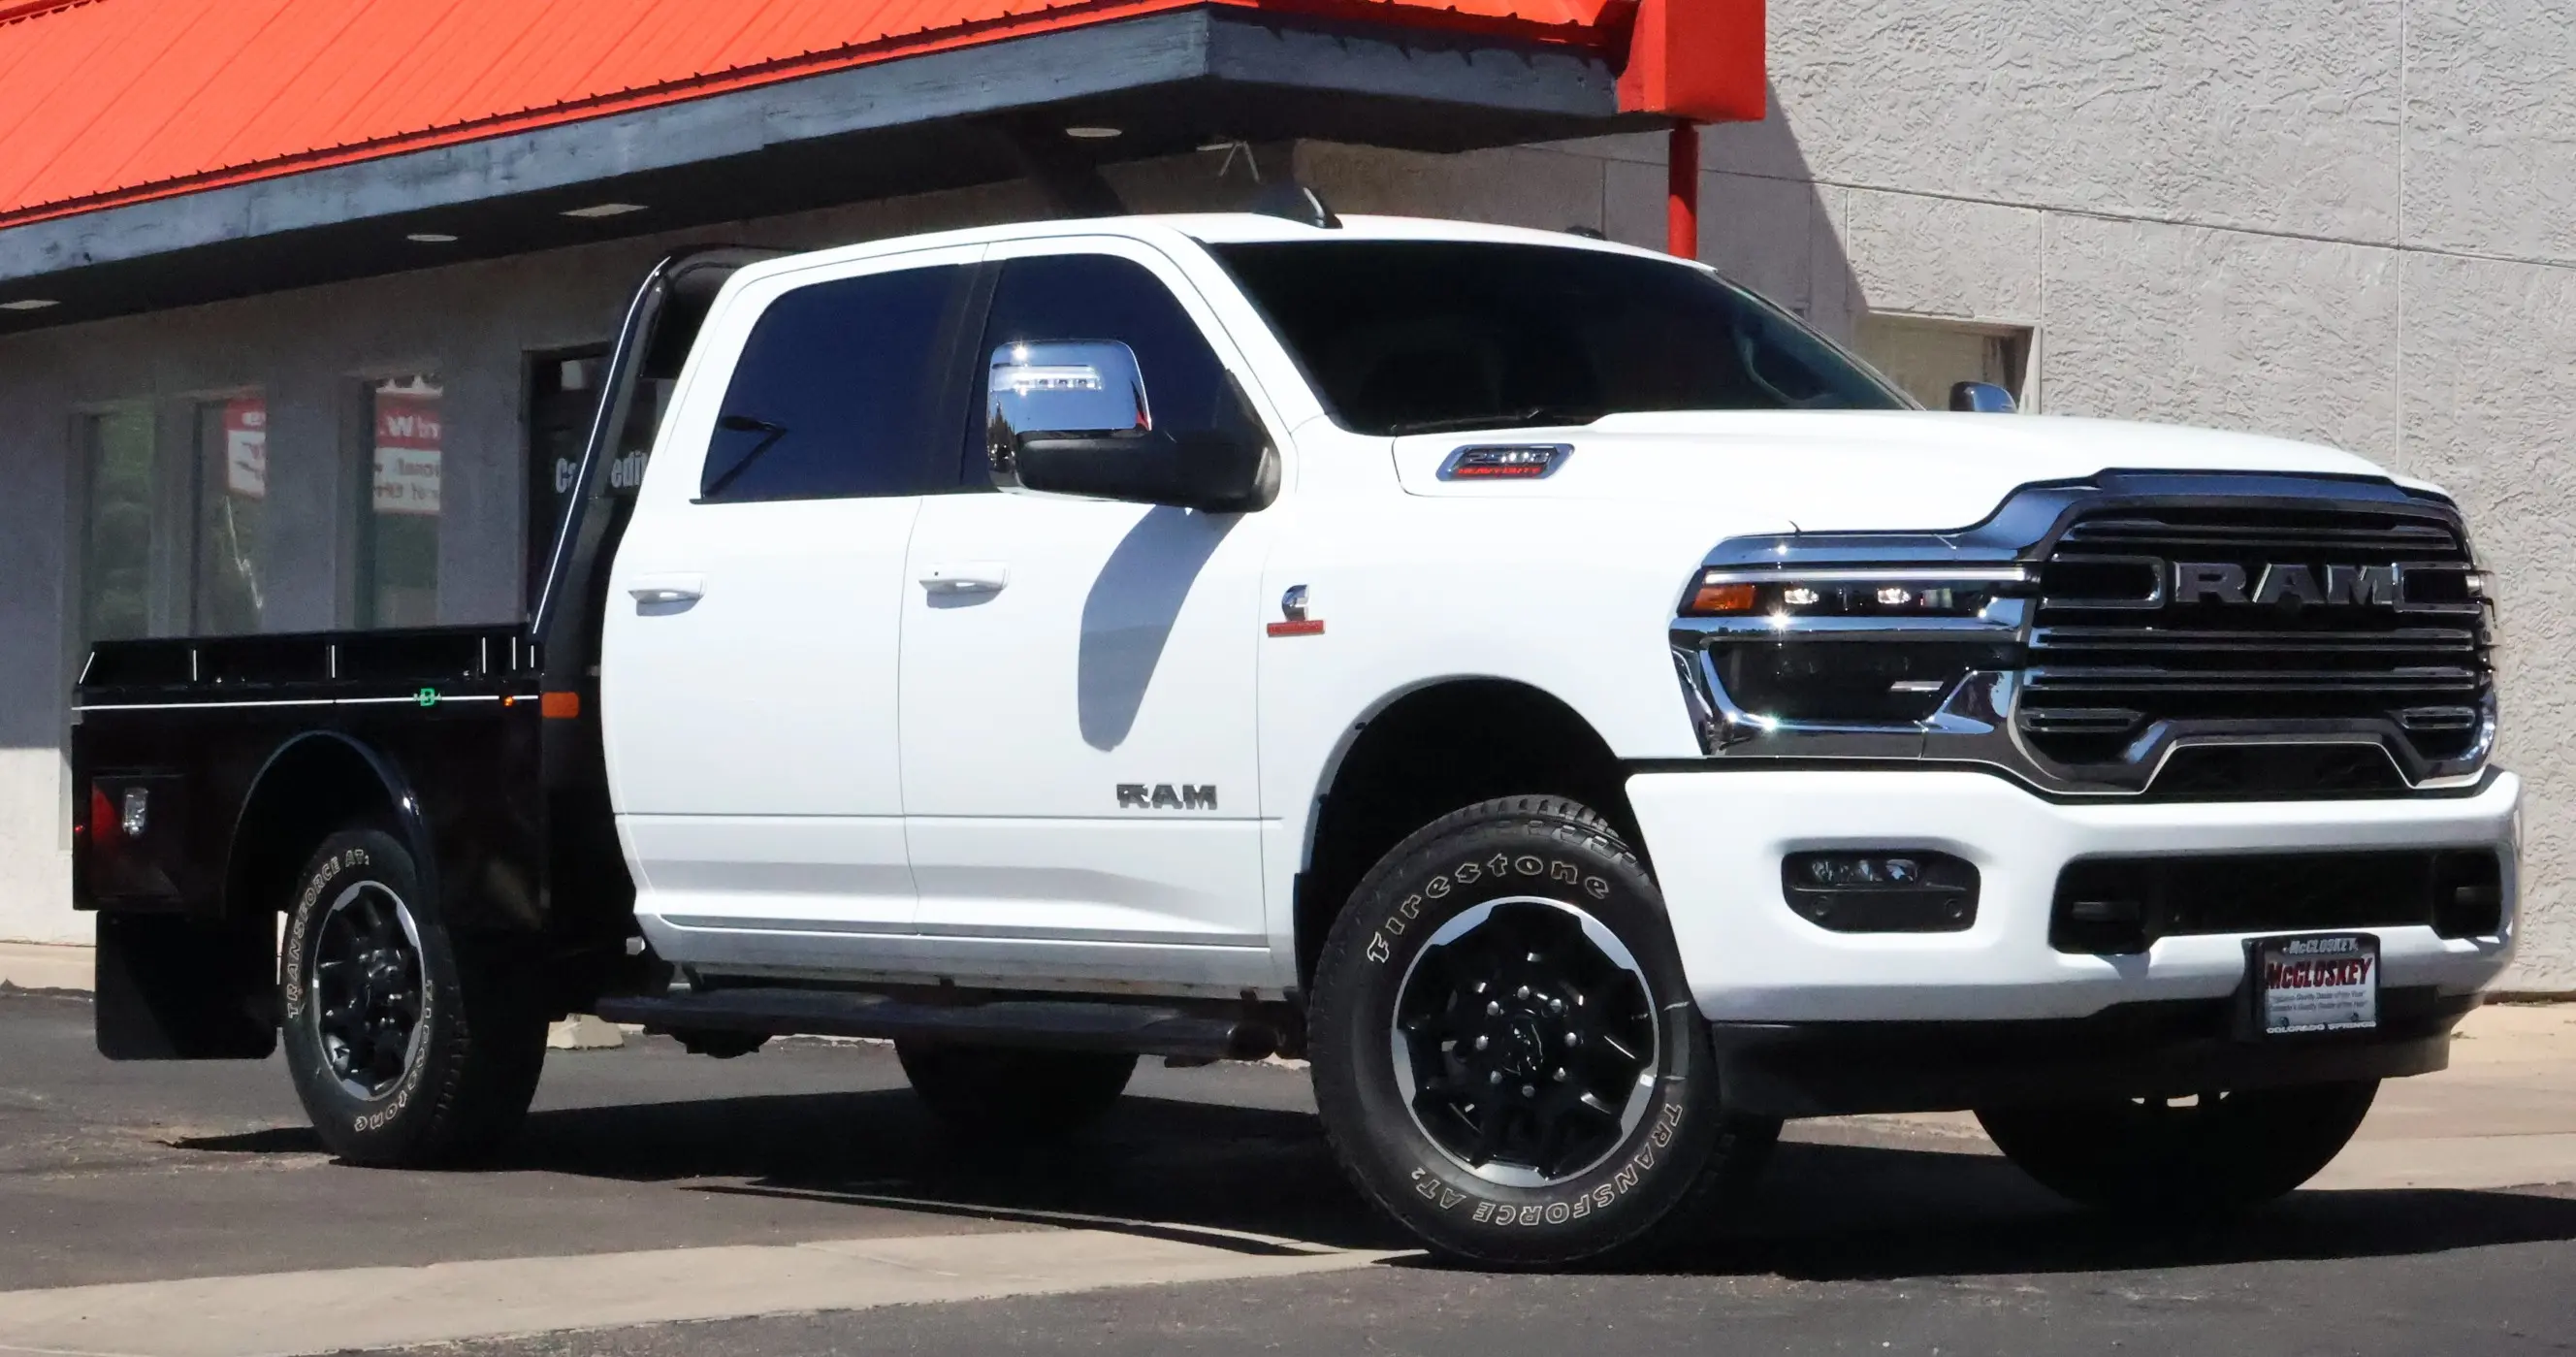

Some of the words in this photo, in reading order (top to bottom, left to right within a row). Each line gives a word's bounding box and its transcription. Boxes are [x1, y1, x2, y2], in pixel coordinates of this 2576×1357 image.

[2173, 561, 2394, 605] RAM
[1116, 784, 1217, 810] RAM
[1367, 853, 1611, 964] Firestone
[285, 856, 341, 1019] TRANSFORCE
[2268, 956, 2373, 989] McCLOSKEY
[2266, 1023, 2325, 1034] COLORADO
[1472, 1102, 1684, 1227] TRANSFORCE
